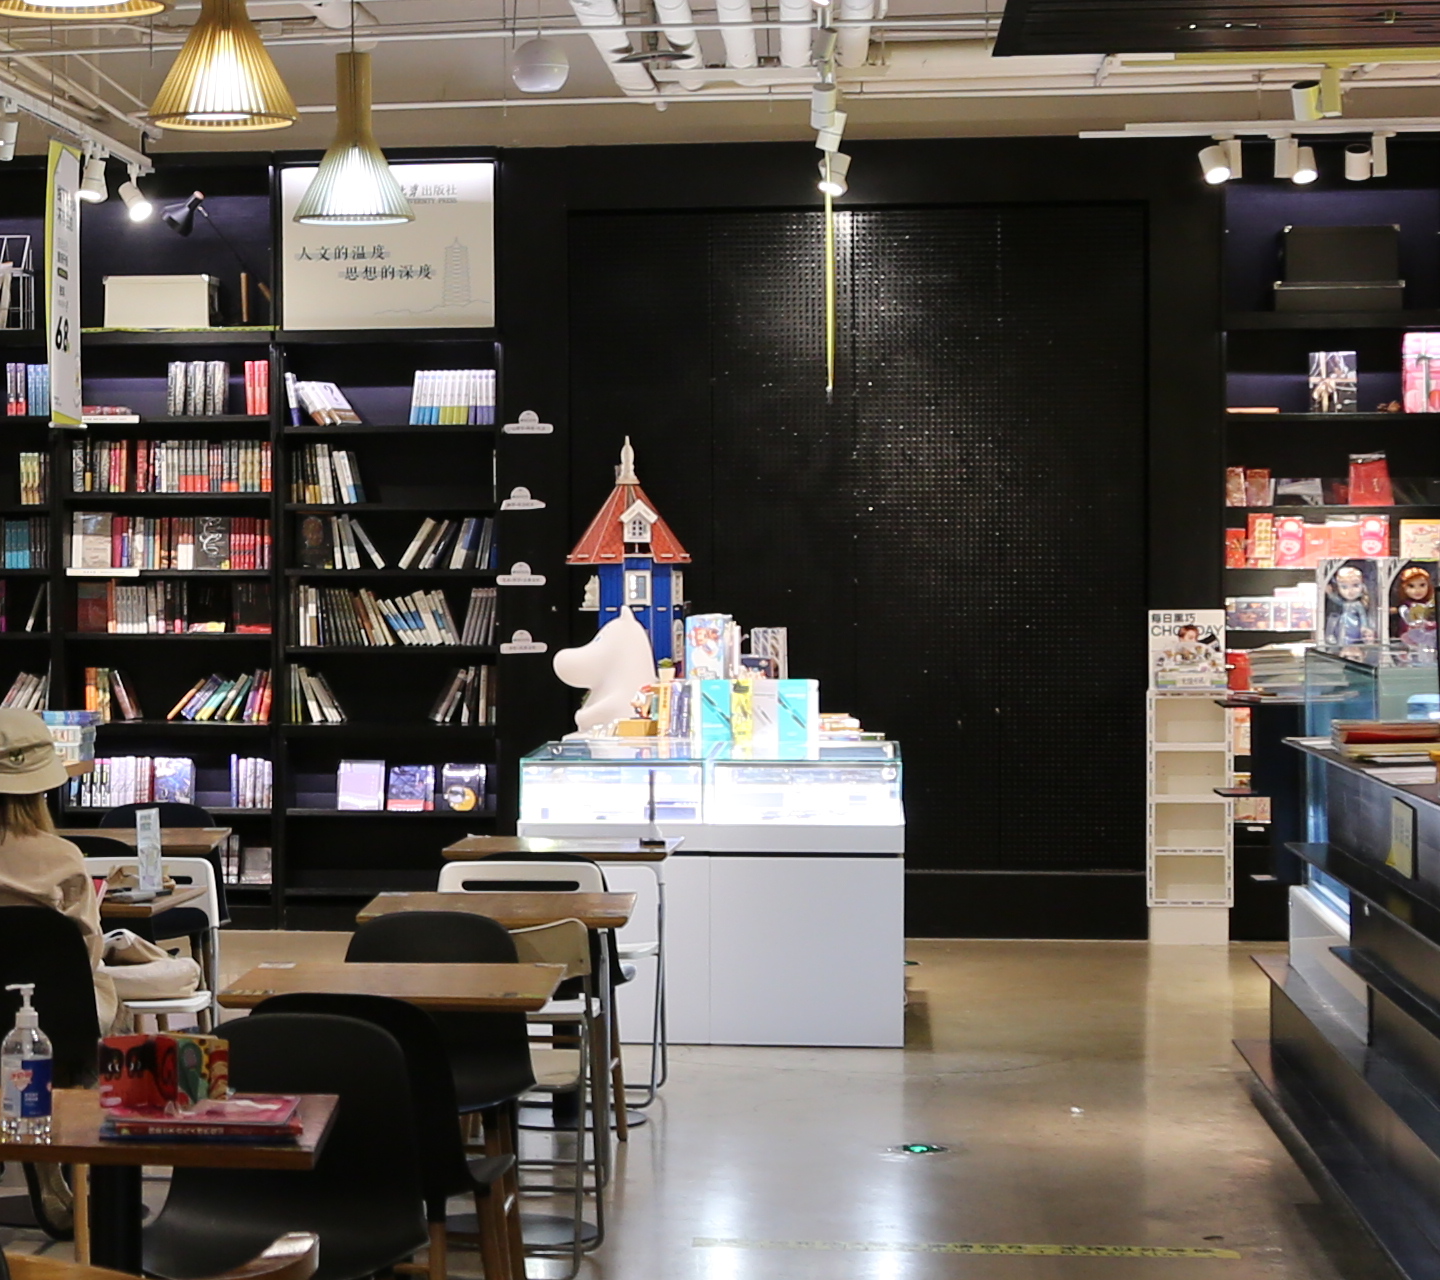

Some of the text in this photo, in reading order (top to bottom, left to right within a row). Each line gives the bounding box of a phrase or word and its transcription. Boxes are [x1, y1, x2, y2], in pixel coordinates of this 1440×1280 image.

[298, 245, 386, 261] 人文的温度
[345, 265, 432, 281] 思想的深度
[1151, 625, 1223, 637] CHODAY
